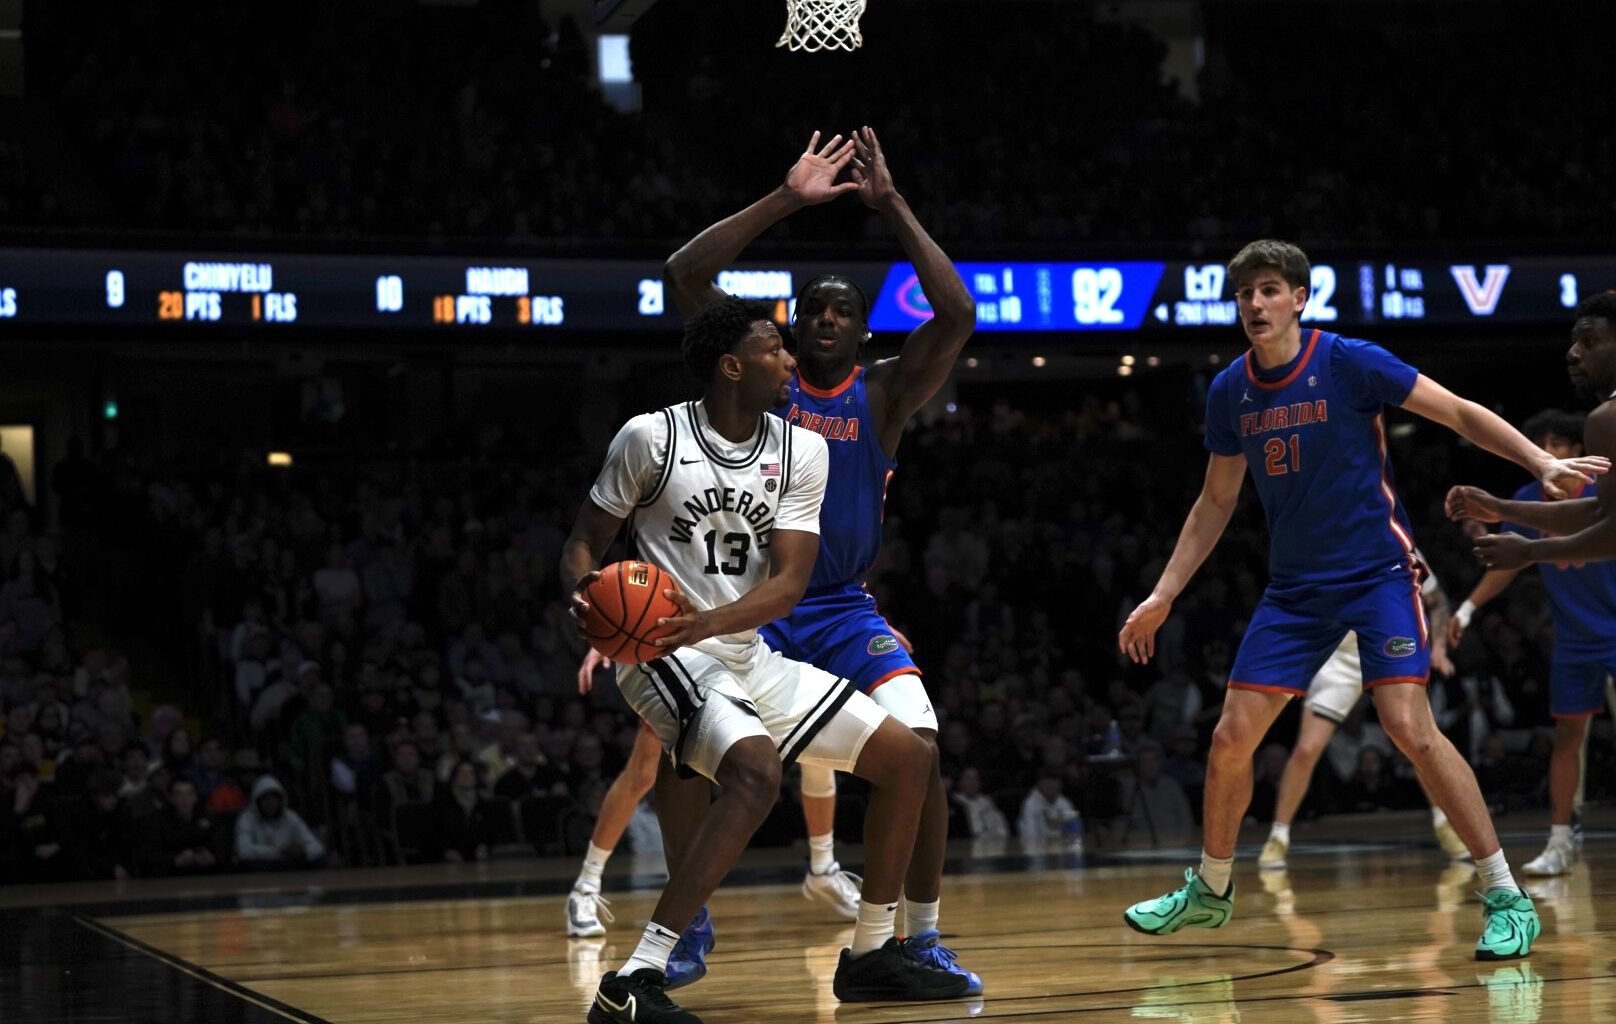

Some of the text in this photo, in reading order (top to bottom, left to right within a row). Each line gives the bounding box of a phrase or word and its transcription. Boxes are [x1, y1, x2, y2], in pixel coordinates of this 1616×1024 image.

[185, 292, 221, 320] PTS
[264, 294, 297, 321] FLS
[456, 295, 491, 324] PTS
[1072, 268, 1124, 324] 92
[1301, 265, 1338, 321] 2
[1450, 265, 1511, 315] V
[785, 403, 859, 441] FORIDA
[1240, 399, 1328, 437] FLORIDA
[1264, 434, 1300, 476] 21
[703, 529, 751, 576] 13
